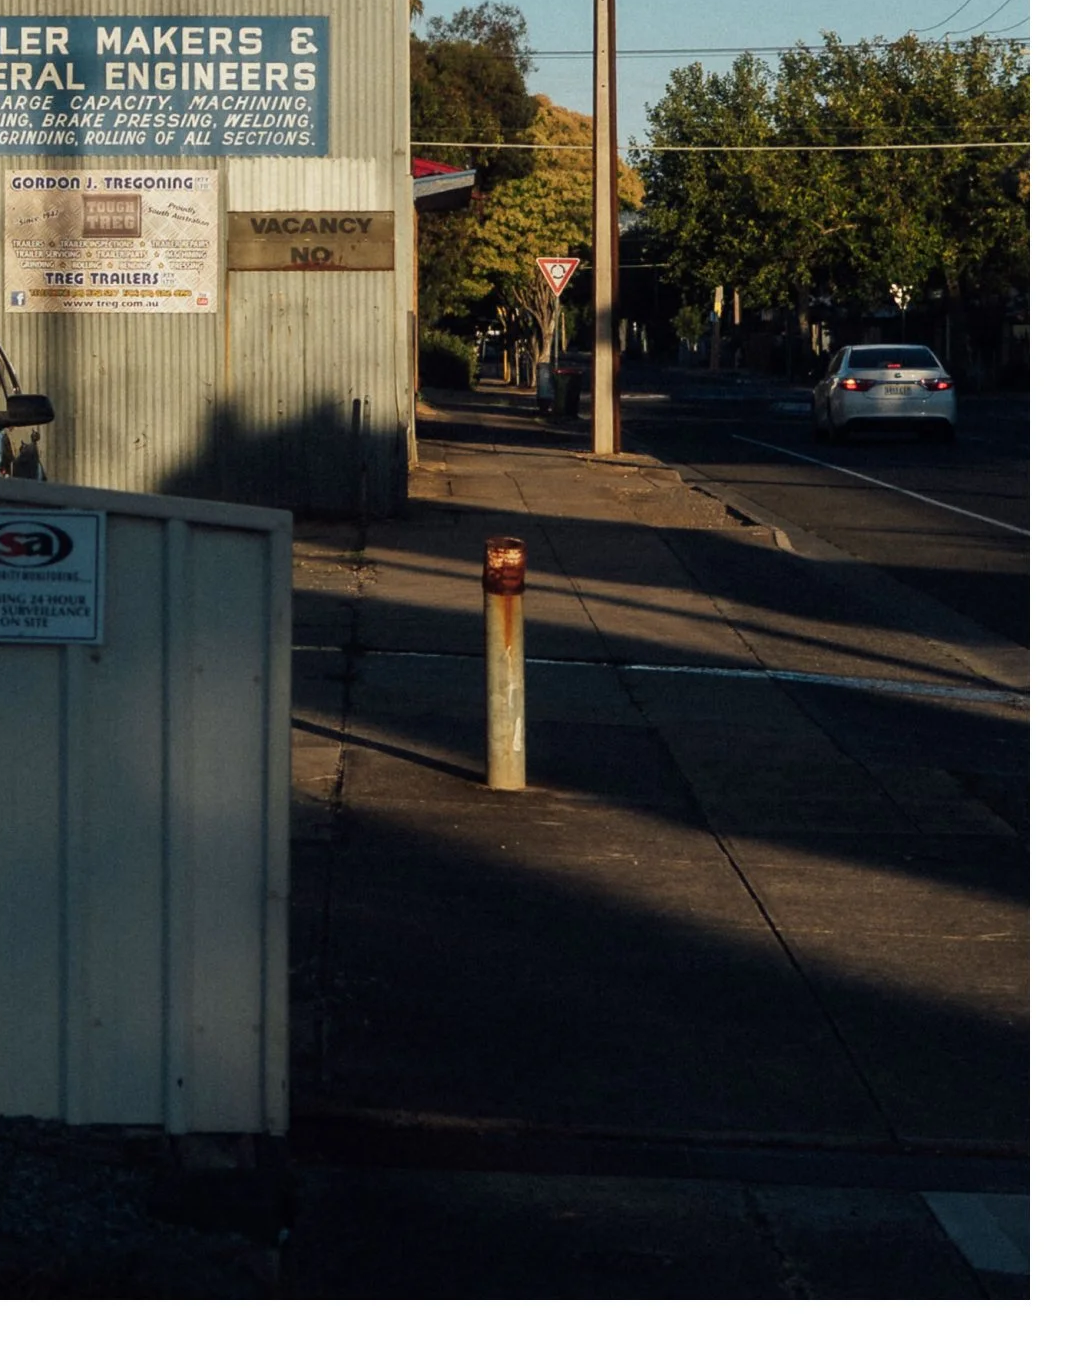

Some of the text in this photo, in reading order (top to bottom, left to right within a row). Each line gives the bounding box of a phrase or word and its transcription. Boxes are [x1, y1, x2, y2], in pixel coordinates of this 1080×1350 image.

[96, 26, 263, 55] MAKERS
[290, 26, 319, 55] &
[105, 62, 317, 91] ENGINEERS
[187, 95, 313, 113] MACHINING,
[42, 113, 106, 128] BRAKE
[113, 113, 218, 130] PRESSING,
[223, 113, 315, 130] WELDING,
[83, 130, 147, 146] ROLLING
[154, 130, 176, 146] OF
[183, 130, 212, 146] ALL
[221, 130, 317, 147] SECTIONS.
[12, 177, 193, 190] GORDON J. TREGONING
[86, 200, 136, 214] TOUGH
[167, 202, 197, 216] Proudly
[86, 215, 136, 230] TREG
[147, 206, 210, 227] South Australian
[251, 217, 373, 235] VACANCY
[12, 239, 45, 248] TRAILERS
[291, 247, 332, 264] NO
[45, 272, 159, 285] TREG TRAILERS
[45, 595, 86, 605] HOUR
[1, 605, 91, 617] SURVEILLANCE
[0, 616, 49, 628] ON SITE
